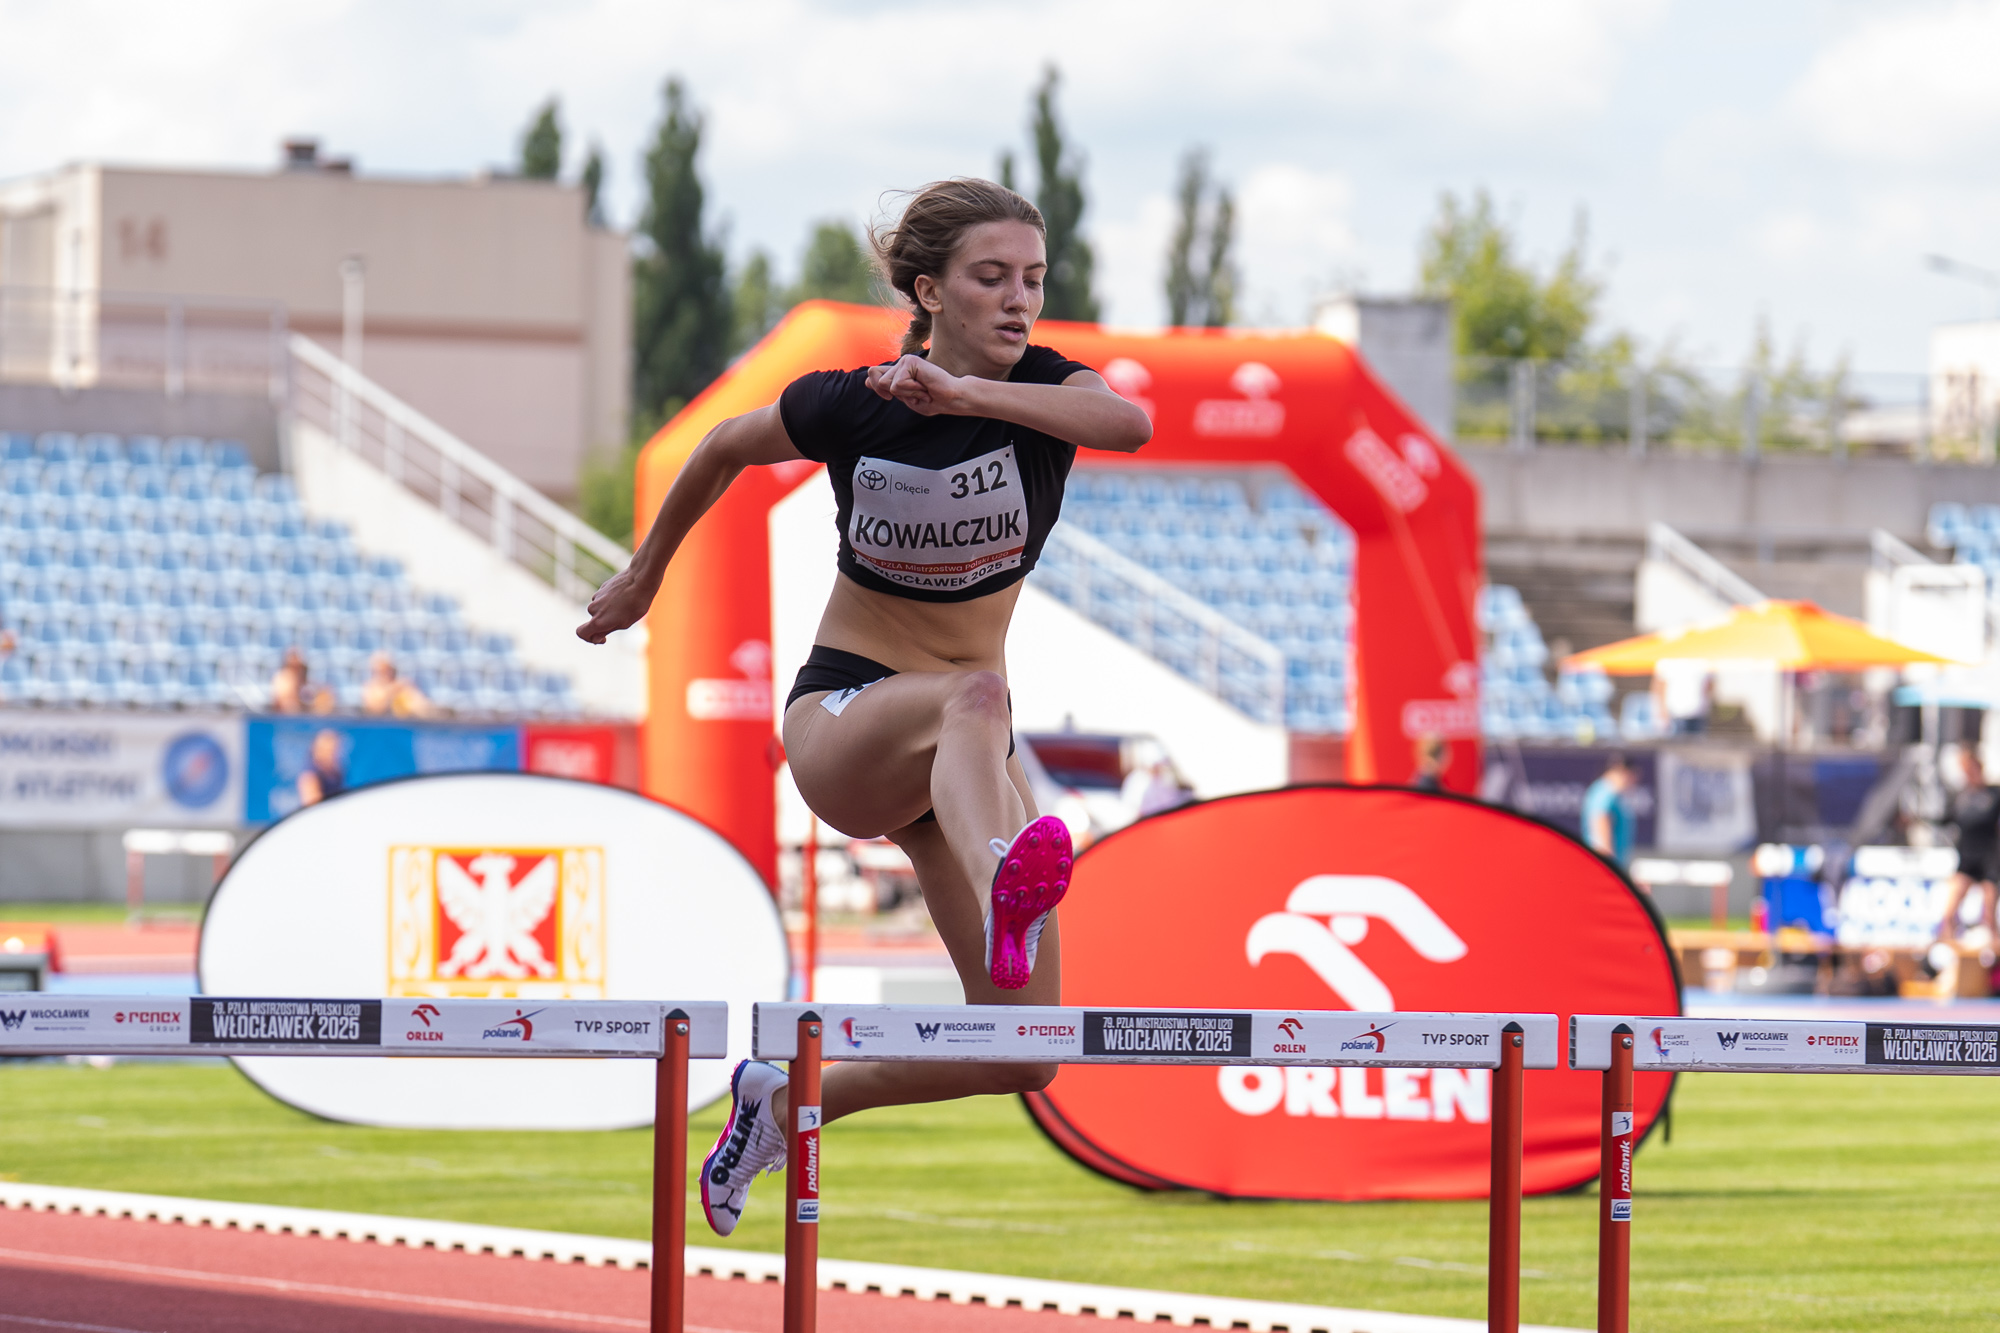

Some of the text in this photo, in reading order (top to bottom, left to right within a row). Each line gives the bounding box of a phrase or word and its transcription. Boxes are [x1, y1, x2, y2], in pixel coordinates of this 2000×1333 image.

[950, 460, 1008, 499] 312
[894, 481, 930, 495] Okęcie
[855, 508, 1022, 549] KOWALCZUK
[880, 561, 903, 570] PZLA
[905, 564, 963, 574] Mistrzostwa
[965, 556, 990, 571] Polski
[971, 561, 1003, 580] 2025
[30, 1009, 90, 1018] WŁOCŁAWEK
[228, 1002, 248, 1015] PZLA
[250, 1002, 310, 1015] MISTRZOSTWA
[312, 1003, 341, 1016] POLSKI
[343, 1004, 361, 1016] U20
[128, 1011, 181, 1023] renex
[1103, 1017, 1233, 1030] 79. PZLA MISTRZOSTWA POLSKI U20
[212, 1015, 360, 1040] WŁOCŁAWEK 2025
[575, 1021, 651, 1034] TVP SPORT
[944, 1023, 996, 1031] WŁOCŁAWEK
[1029, 1025, 1076, 1037] renex
[406, 1031, 443, 1041] ORLEN
[482, 1028, 522, 1040] polanik
[1103, 1029, 1232, 1052] WŁOCŁAWEK 2025
[1422, 1033, 1490, 1046] TVP SPORT
[1742, 1032, 1789, 1040] WŁOCŁAWEK
[1818, 1035, 1859, 1046] renex
[1894, 1029, 1911, 1040] PZLA
[1912, 1029, 1958, 1041] MISTRZOSTWA
[1960, 1030, 1983, 1042] POLSKI
[1984, 1031, 1998, 1042] U20
[1273, 1044, 1306, 1054] ORLEN
[1340, 1040, 1375, 1052] polanik
[1883, 1040, 1997, 1062] WŁOCŁAWEK 2025
[1217, 1066, 1492, 1124] ORLEN
[805, 1136, 818, 1193] polanik
[1619, 1140, 1631, 1193] polanik
